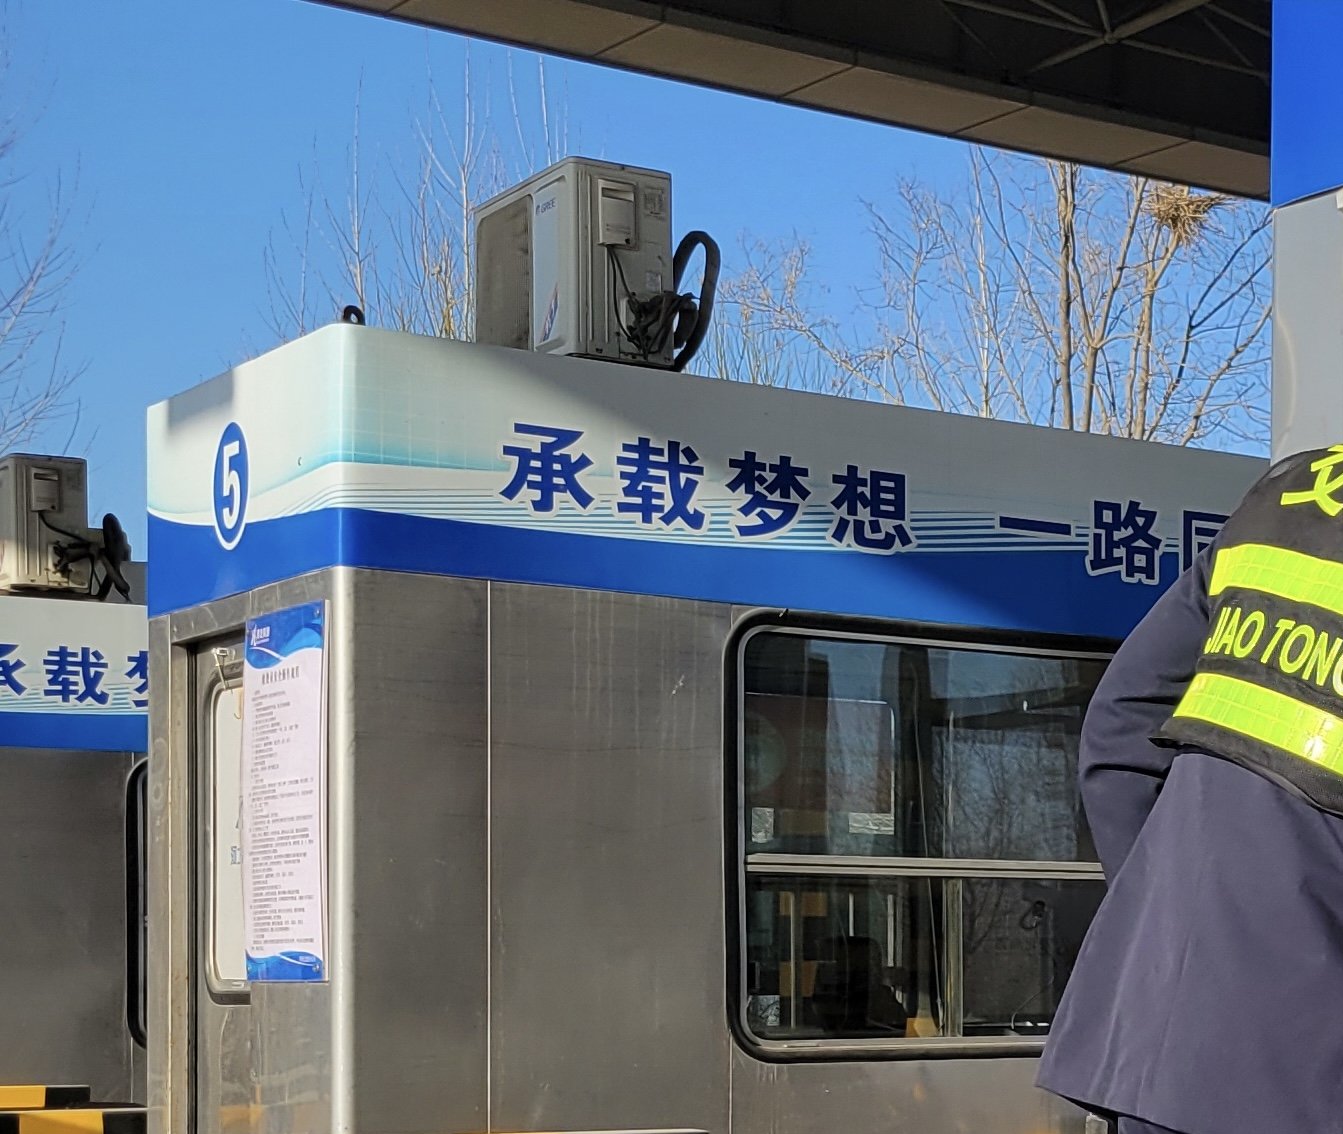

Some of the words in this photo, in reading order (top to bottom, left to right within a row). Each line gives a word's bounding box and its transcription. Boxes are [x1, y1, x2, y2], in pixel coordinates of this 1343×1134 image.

[541, 199, 557, 213] GREE
[222, 440, 240, 529] 5
[500, 423, 914, 551] 承载梦想
[1205, 606, 1266, 660] JIAO
